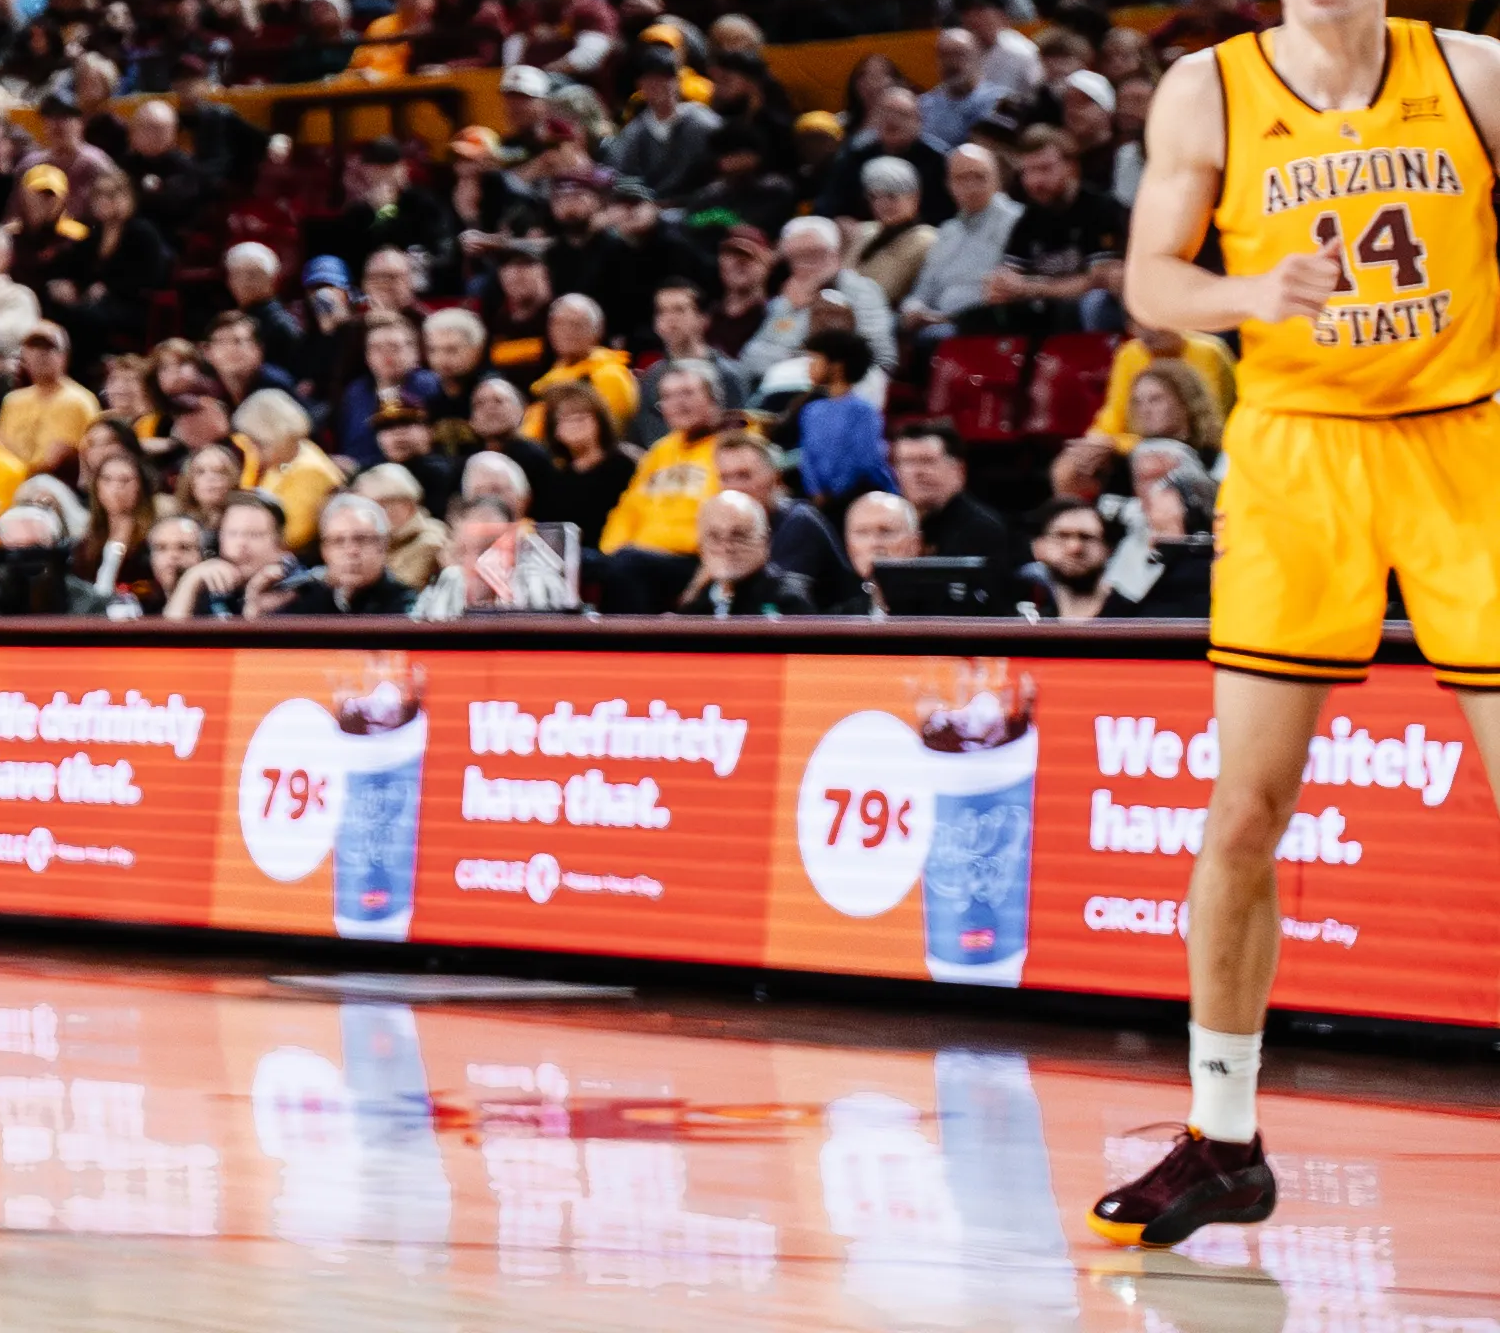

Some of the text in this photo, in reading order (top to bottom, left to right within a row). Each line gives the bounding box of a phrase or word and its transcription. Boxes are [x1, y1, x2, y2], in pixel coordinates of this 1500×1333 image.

[1264, 147, 1464, 216] ARIZONA
[1312, 202, 1429, 297] 14
[1313, 289, 1453, 348] STATE
[39, 688, 205, 759] definitely
[468, 697, 748, 776] We definitely
[56, 751, 142, 807] that.
[1094, 715, 1463, 807] We dnitely
[462, 765, 672, 829] have that.
[1090, 788, 1363, 864] hav at.
[455, 858, 526, 893] CIRCLE
[1084, 895, 1177, 936] CIRCLE
